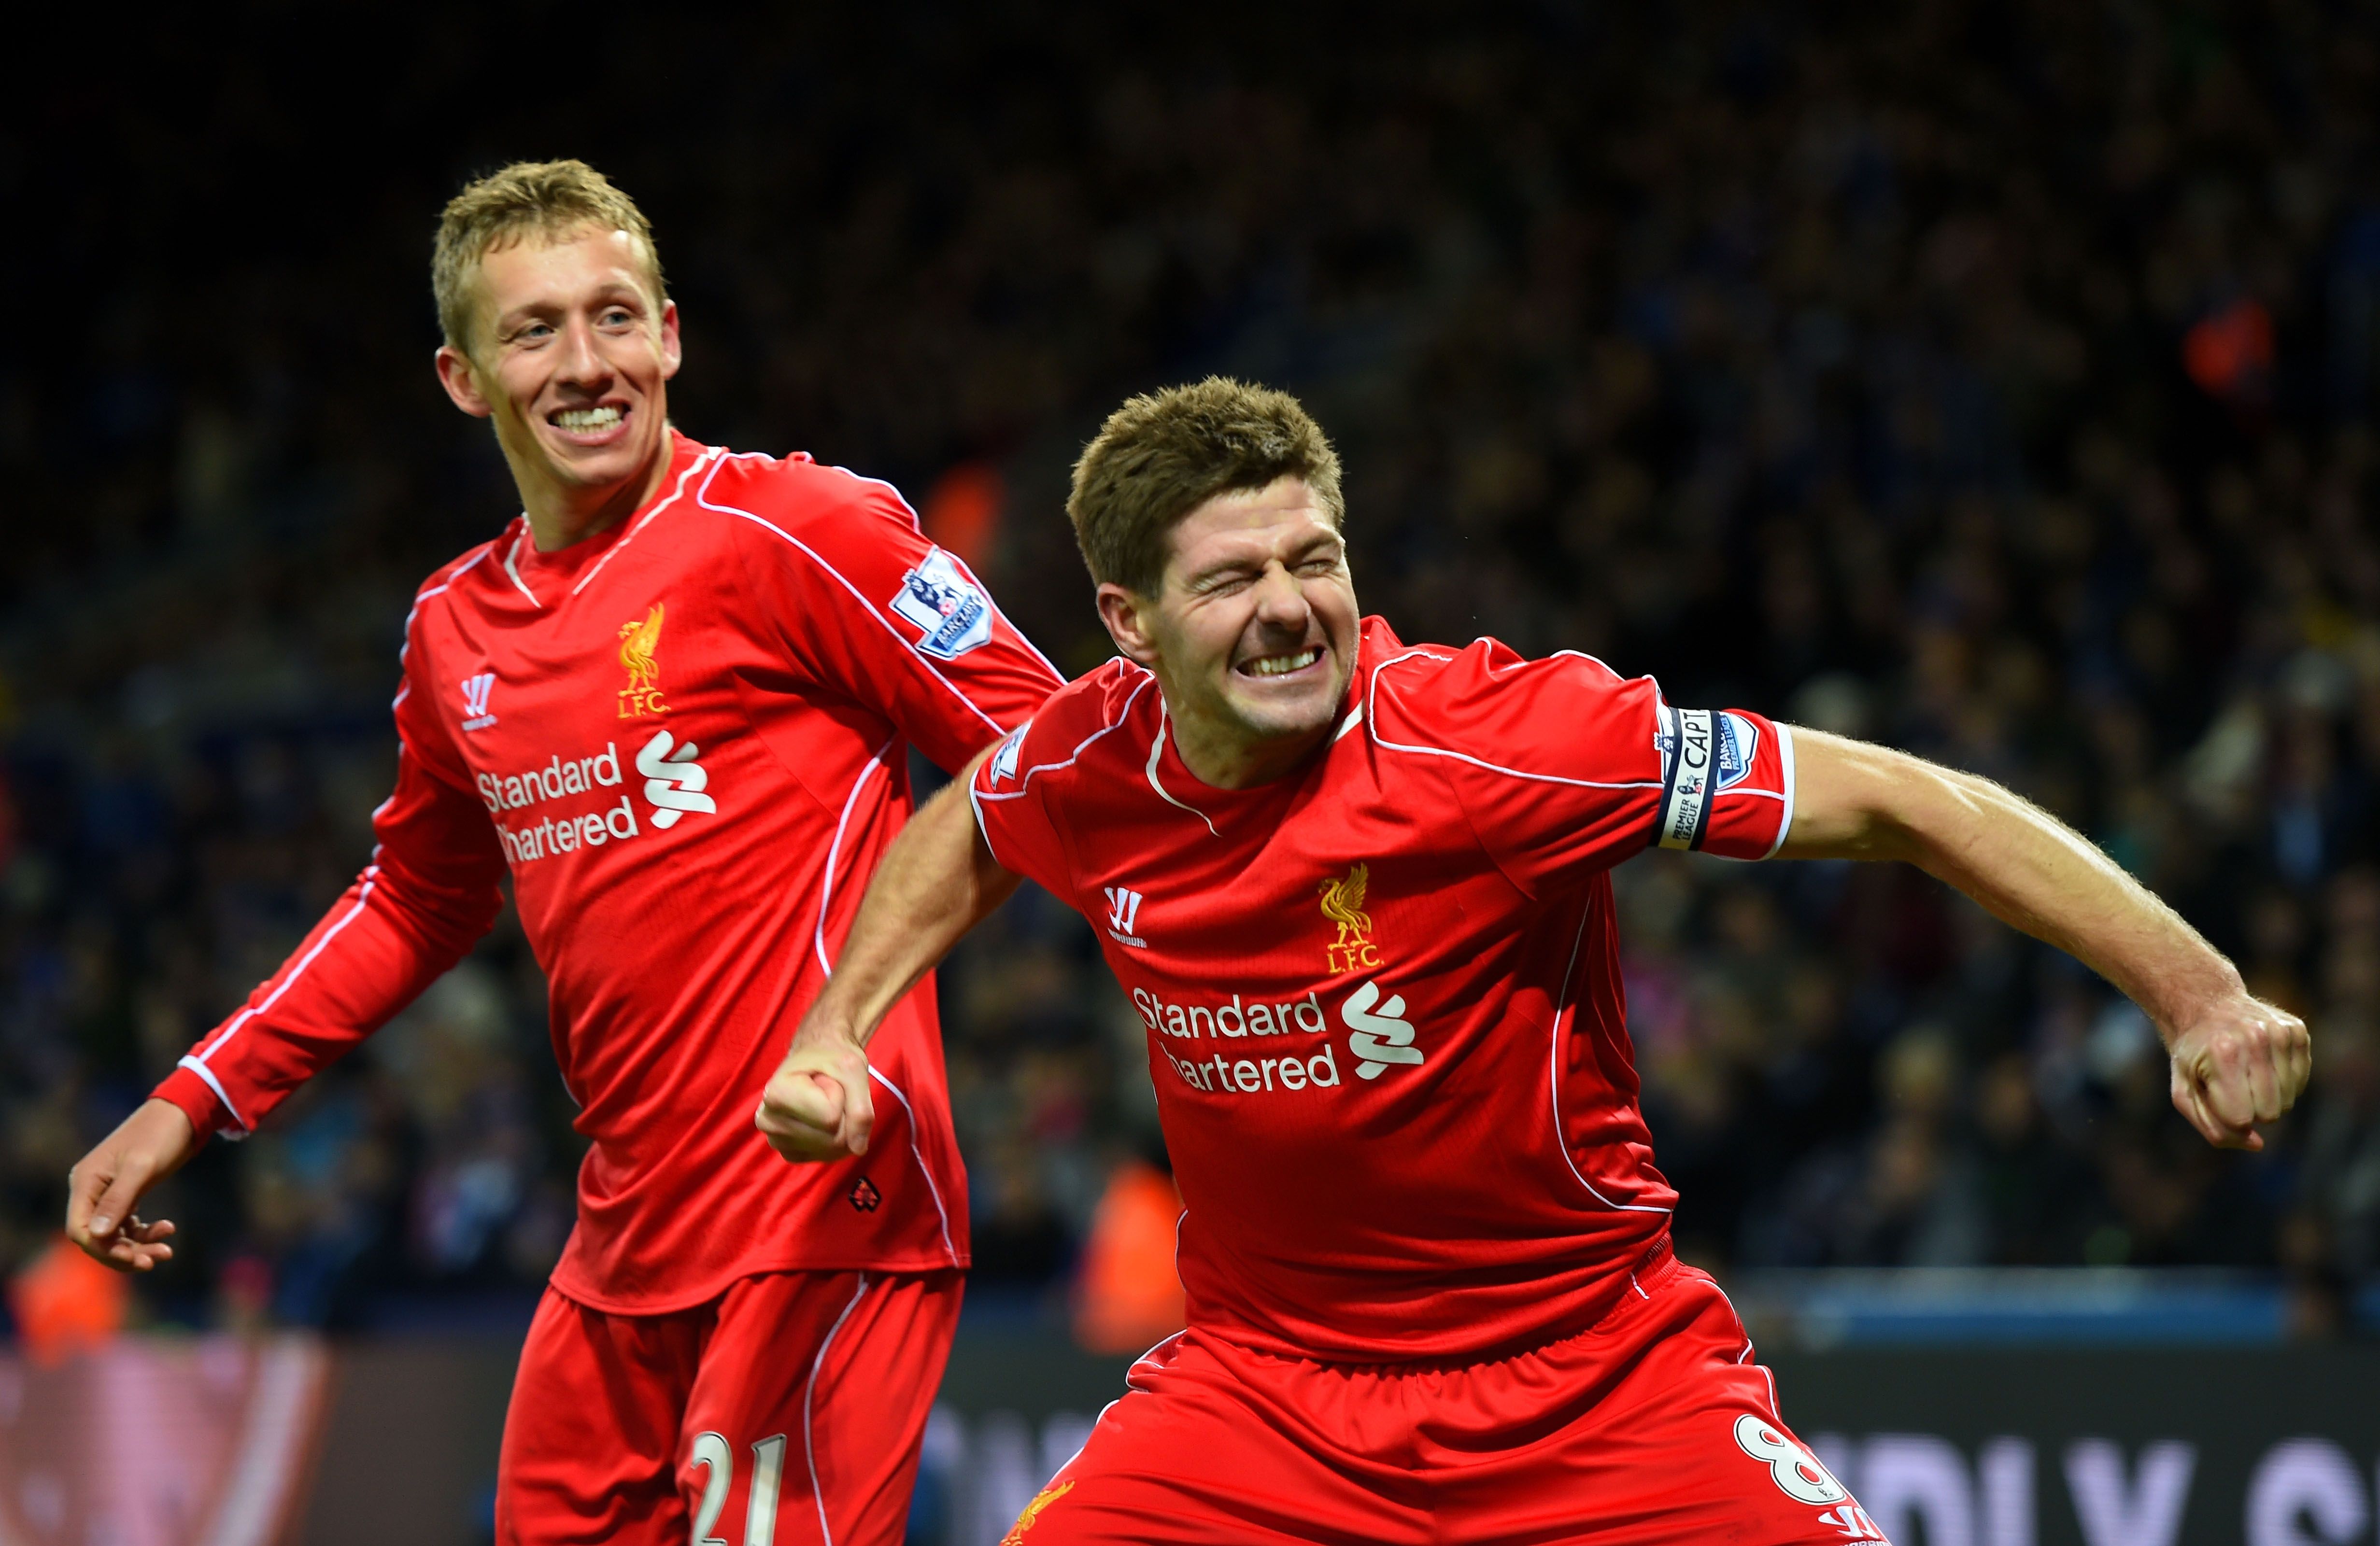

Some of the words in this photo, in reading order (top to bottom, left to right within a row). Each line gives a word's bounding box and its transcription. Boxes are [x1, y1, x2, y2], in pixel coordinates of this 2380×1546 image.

[1683, 710, 1708, 768] CAPT
[478, 742, 623, 813] Standard
[496, 795, 638, 863] hartered
[1672, 799, 1690, 839] PREMIER
[1682, 803, 1699, 839] LEAGUE
[1133, 987, 1326, 1038] Standard
[1155, 1038, 1340, 1093] hartered
[1733, 1413, 1847, 1505] 8
[690, 1431, 787, 1546] 21
